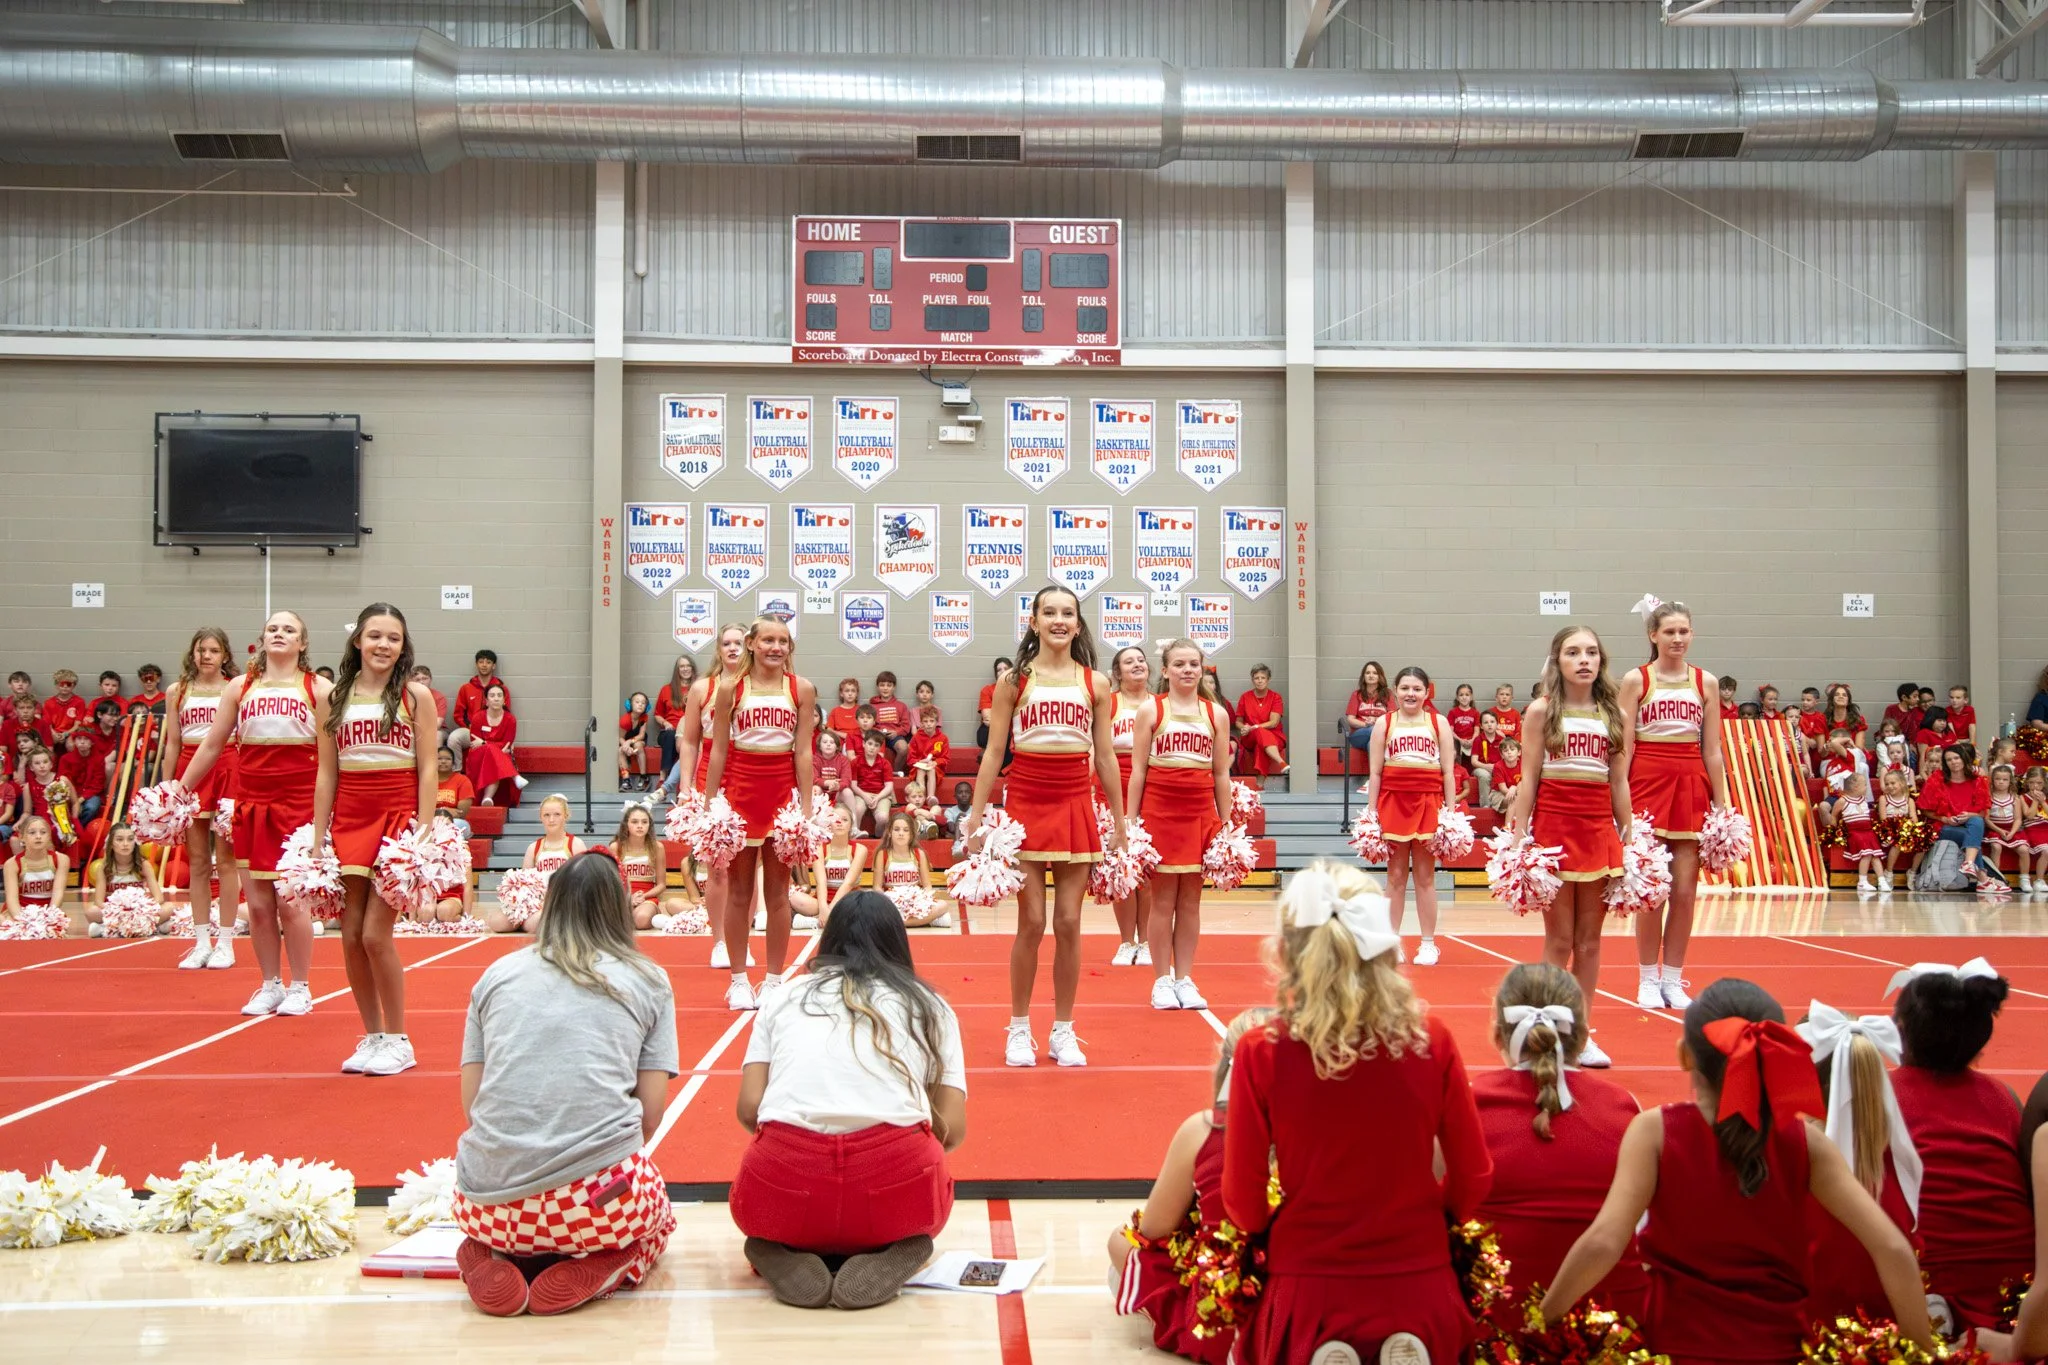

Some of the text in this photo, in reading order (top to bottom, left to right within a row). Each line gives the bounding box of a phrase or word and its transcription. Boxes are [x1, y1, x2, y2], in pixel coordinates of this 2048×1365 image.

[807, 223, 861, 241] HOME
[1049, 225, 1109, 244] GUEST
[930, 274, 964, 283] PERIOD
[806, 294, 836, 304] FOULS
[868, 294, 892, 304] T.O.L.
[922, 295, 992, 305] PLAYER FOUL
[1022, 296, 1046, 306] T.O.L.
[1077, 296, 1107, 306] FOULS
[806, 332, 836, 342] SCORE
[940, 333, 972, 343] MATCH
[1077, 334, 1107, 344] SCORE
[798, 350, 866, 360] Scoreboard
[870, 350, 920, 361] Donated
[924, 350, 938, 364] by
[941, 352, 982, 362] Electra
[1092, 352, 1114, 362] Inc.
[754, 435, 808, 448] VOLLEYBALL
[838, 435, 894, 448] VOLLEYBALL
[1010, 438, 1064, 448] VOLLEYBALL
[1096, 439, 1150, 450] BASKETBALL
[1182, 440, 1236, 450] GIRLS ATHLETICS
[666, 446, 722, 458] CHAMPIONS
[752, 447, 808, 459] CHAMPION
[838, 447, 893, 460] CHAMPION
[1010, 448, 1064, 460] CHAMPION
[1096, 450, 1150, 462] RUNNERUP
[1181, 449, 1236, 460] CHAMPION
[680, 461, 708, 473] 2018
[776, 460, 787, 468] 1A
[852, 462, 880, 472] 2020
[1023, 463, 1051, 473] 2021
[1108, 464, 1136, 474] 2021
[1194, 464, 1222, 474] 2021
[769, 470, 792, 478] 2018
[1032, 475, 1044, 483] 1A
[1118, 476, 1129, 484] 1A
[1204, 476, 1214, 484] 1A
[630, 542, 684, 554] VOLLEYBALL
[708, 543, 764, 555] BASKETBALL
[795, 542, 850, 554] BASKETBALL
[968, 544, 1022, 555] TENNIS
[1053, 544, 1108, 556] VOLLEYBALL
[1138, 546, 1192, 558] VOLLEYBALL
[1237, 546, 1270, 558] GOLF
[600, 518, 614, 606] WARRIORS
[629, 553, 684, 566] CHAMPION
[708, 554, 764, 567] CHAMPIONS
[794, 554, 850, 566] CHAMPIONS
[968, 555, 1022, 566] CHAMPION
[1052, 556, 1108, 568] CHAMPION
[1138, 557, 1192, 569] CHAMPION
[1226, 558, 1280, 570] CHAMPION
[880, 562, 934, 574] CHAMPION
[1295, 522, 1308, 610] WARRIORS
[642, 568, 672, 578] 2022
[721, 569, 750, 579] 2022
[808, 568, 836, 578] 2022
[980, 570, 1010, 580] 2023
[1066, 570, 1094, 580] 2023
[1151, 572, 1180, 582] 2024
[1239, 572, 1268, 582] 2025
[652, 580, 664, 588] 1A
[730, 581, 742, 589] 1A
[818, 580, 828, 588] 1A
[990, 582, 1001, 590] 1A
[1075, 582, 1086, 590] 1A
[1160, 584, 1171, 592] 1A
[1248, 584, 1259, 592] 1A
[676, 628, 714, 636] CHAMPION
[847, 631, 882, 640] RUNNER-UP
[241, 697, 308, 723] WARRIORS
[1642, 700, 1703, 725] WARRIORS
[180, 707, 217, 727] WARRIO
[737, 708, 796, 732] WARRIORS
[1020, 702, 1090, 734] WARRIORS
[1156, 732, 1213, 758] WARRIORS
[1388, 736, 1436, 758] WARRIORS
[1549, 733, 1610, 762] RRIOR
